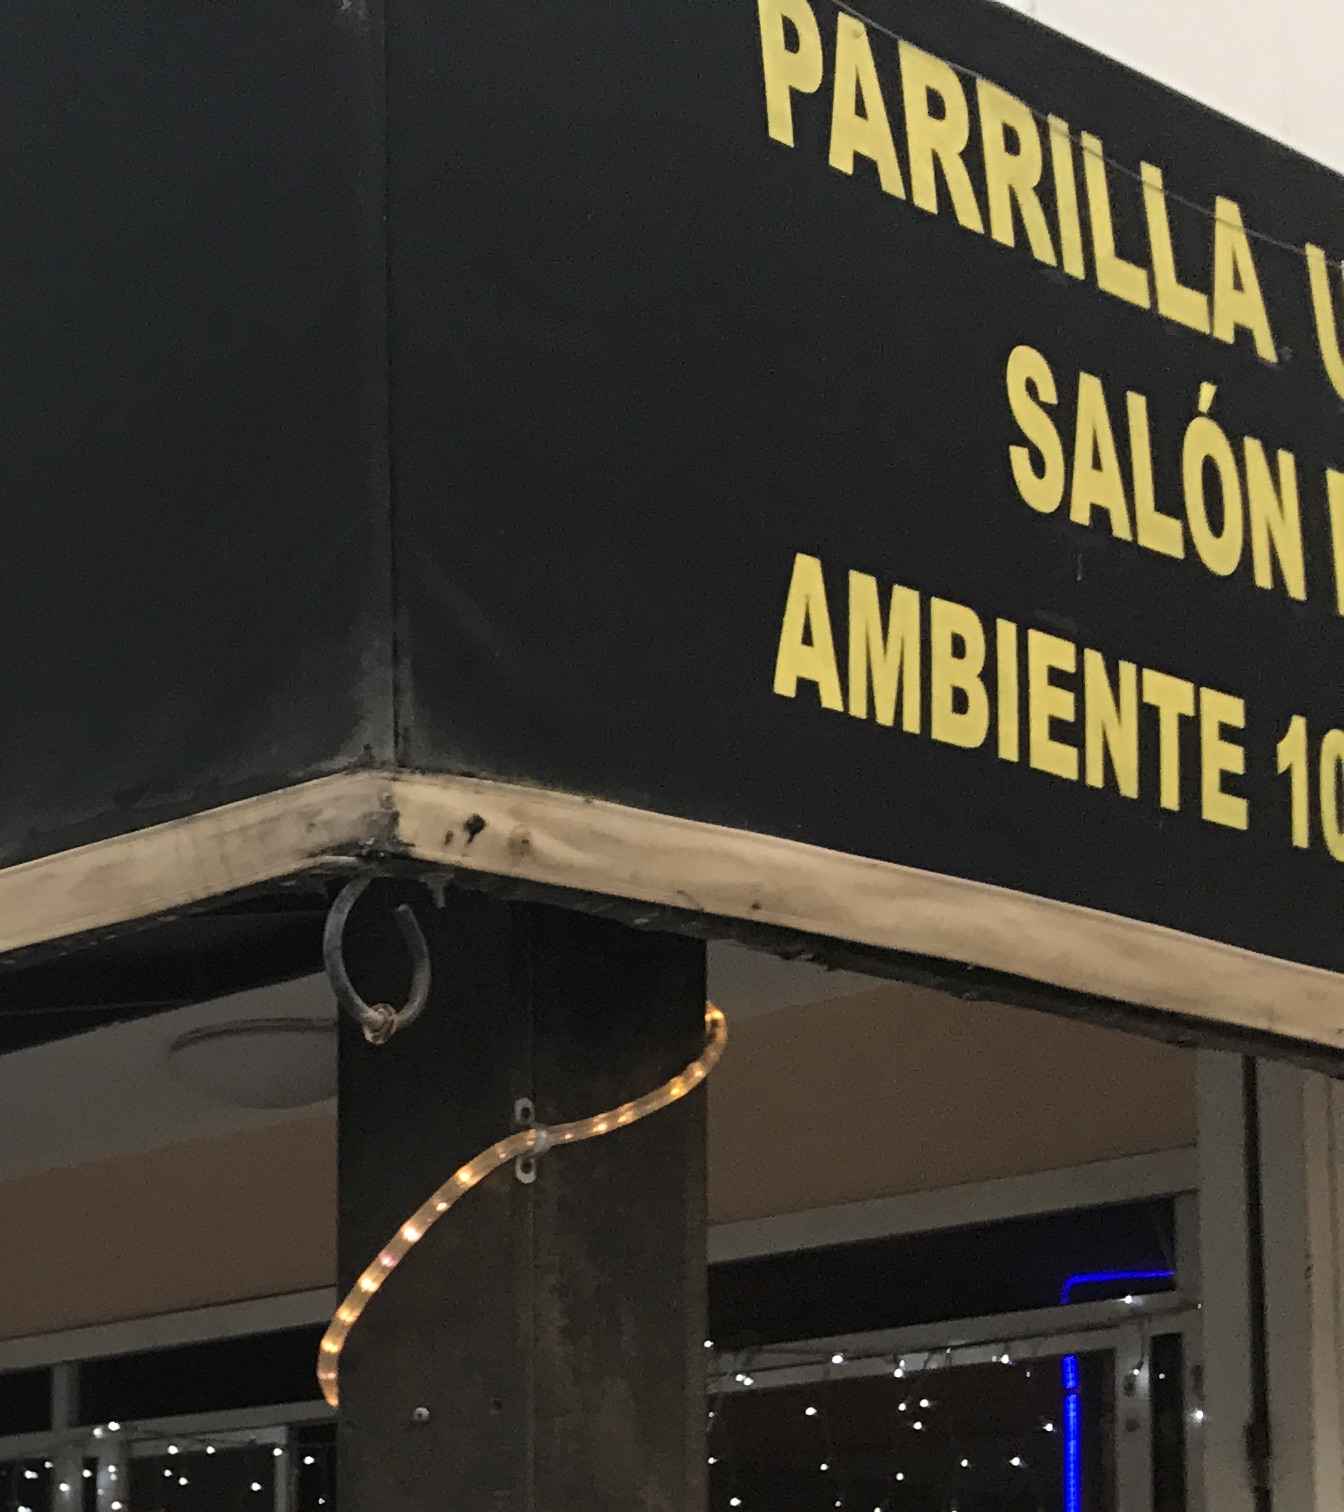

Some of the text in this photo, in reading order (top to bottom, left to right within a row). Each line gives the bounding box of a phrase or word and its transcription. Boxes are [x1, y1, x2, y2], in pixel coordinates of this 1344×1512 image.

[758, 0, 1278, 364] PARRILLA
[1005, 344, 1308, 601] SALÓN
[773, 552, 1249, 831] AMBIENTE
